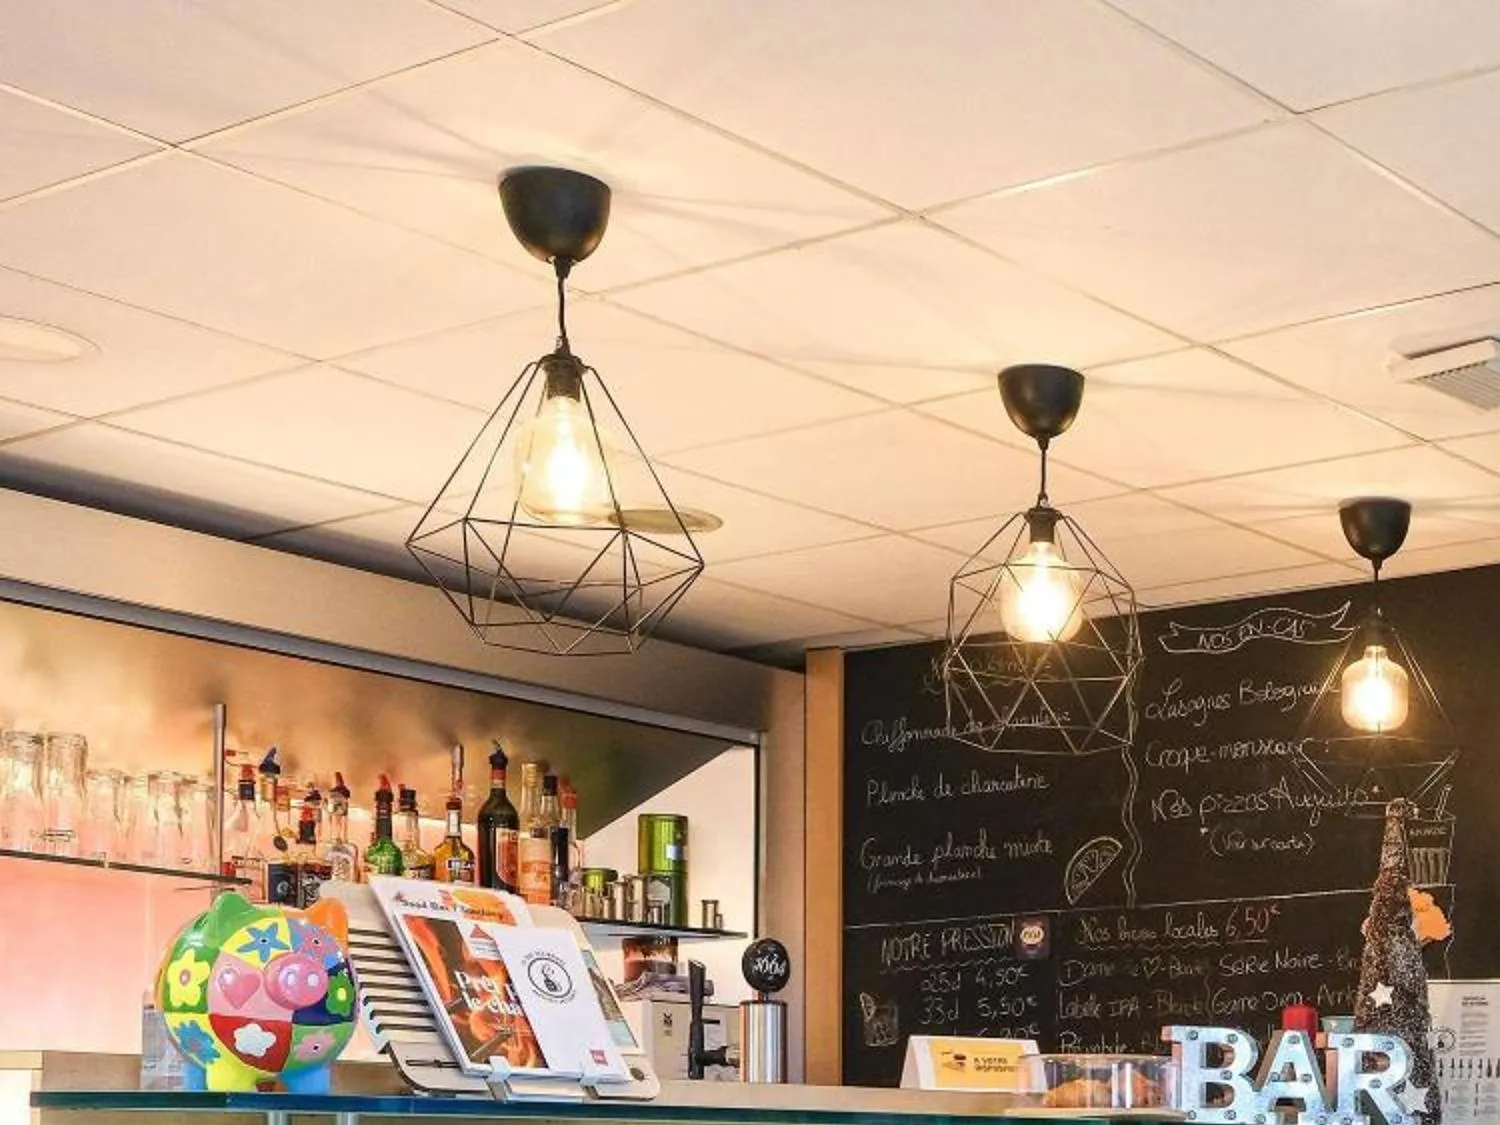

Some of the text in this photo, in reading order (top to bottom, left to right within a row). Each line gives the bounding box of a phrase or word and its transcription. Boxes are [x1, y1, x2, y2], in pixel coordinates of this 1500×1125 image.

[934, 771, 953, 798] de
[860, 837, 924, 870] Grande
[931, 827, 999, 870] planche
[1163, 911, 1219, 938] locales
